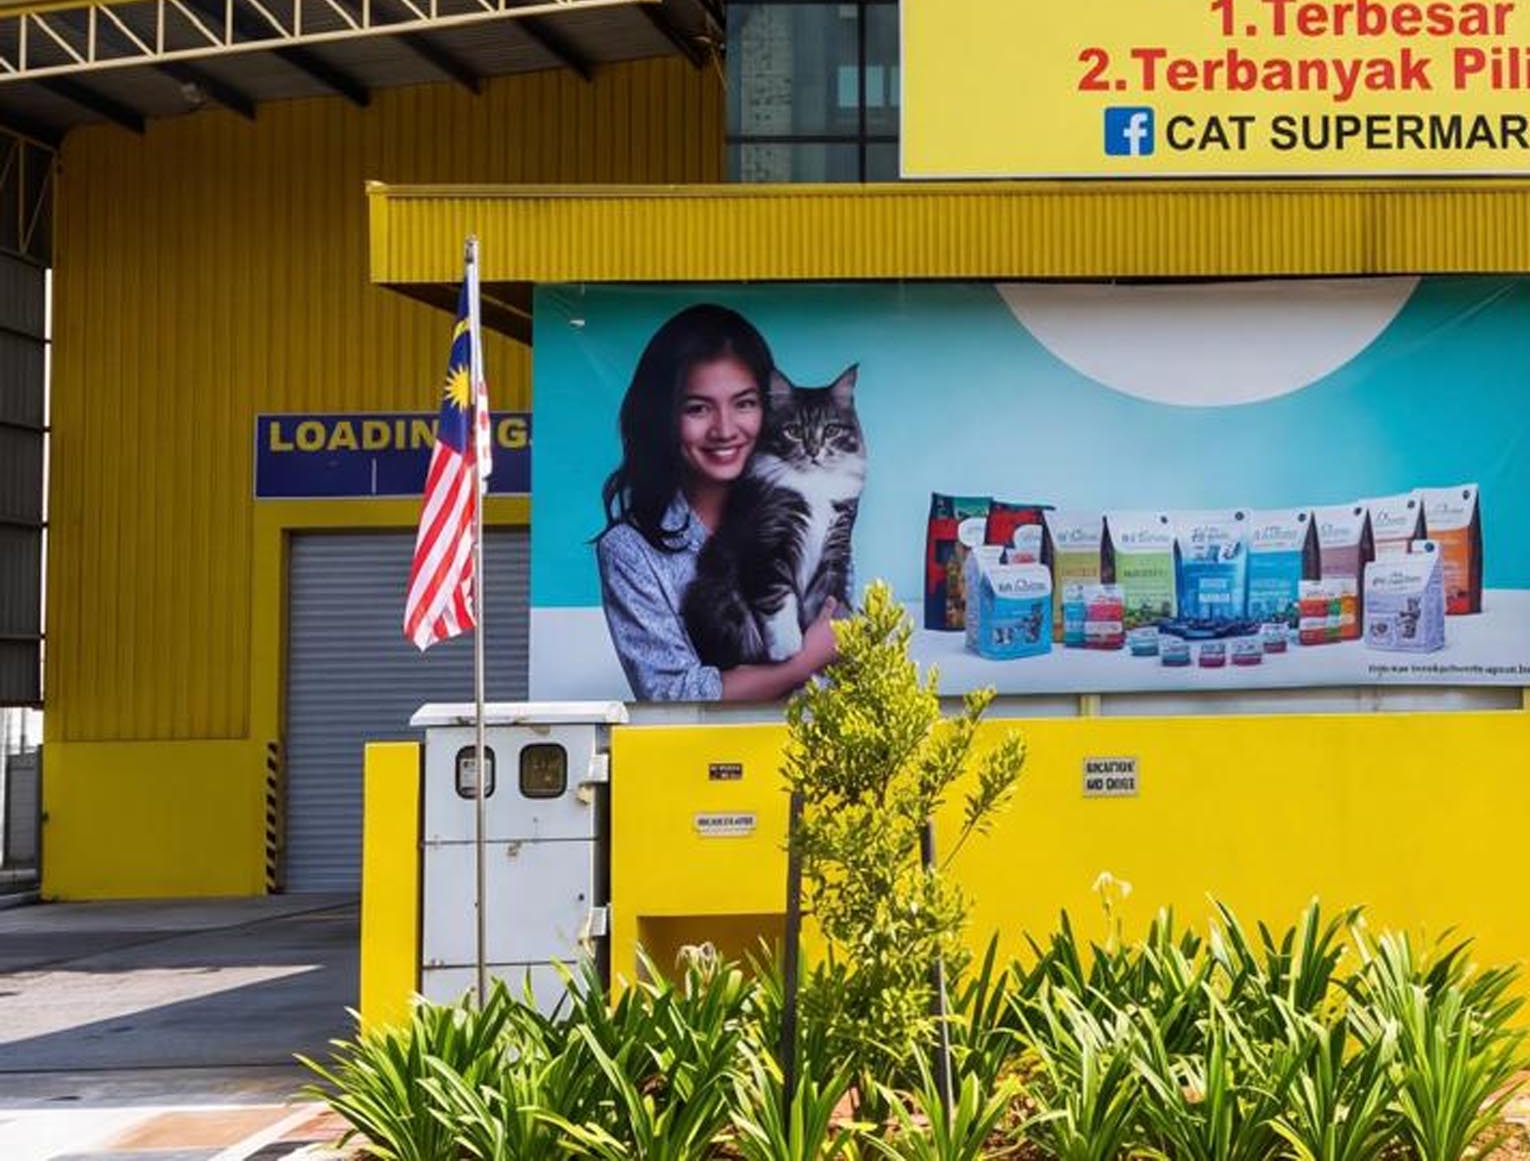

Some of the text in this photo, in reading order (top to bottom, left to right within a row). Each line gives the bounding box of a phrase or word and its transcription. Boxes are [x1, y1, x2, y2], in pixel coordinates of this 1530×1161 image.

[1078, 46, 1431, 102] 2.Terbanyak
[1165, 115, 1256, 150] CAT
[269, 420, 440, 451] LOADIN
